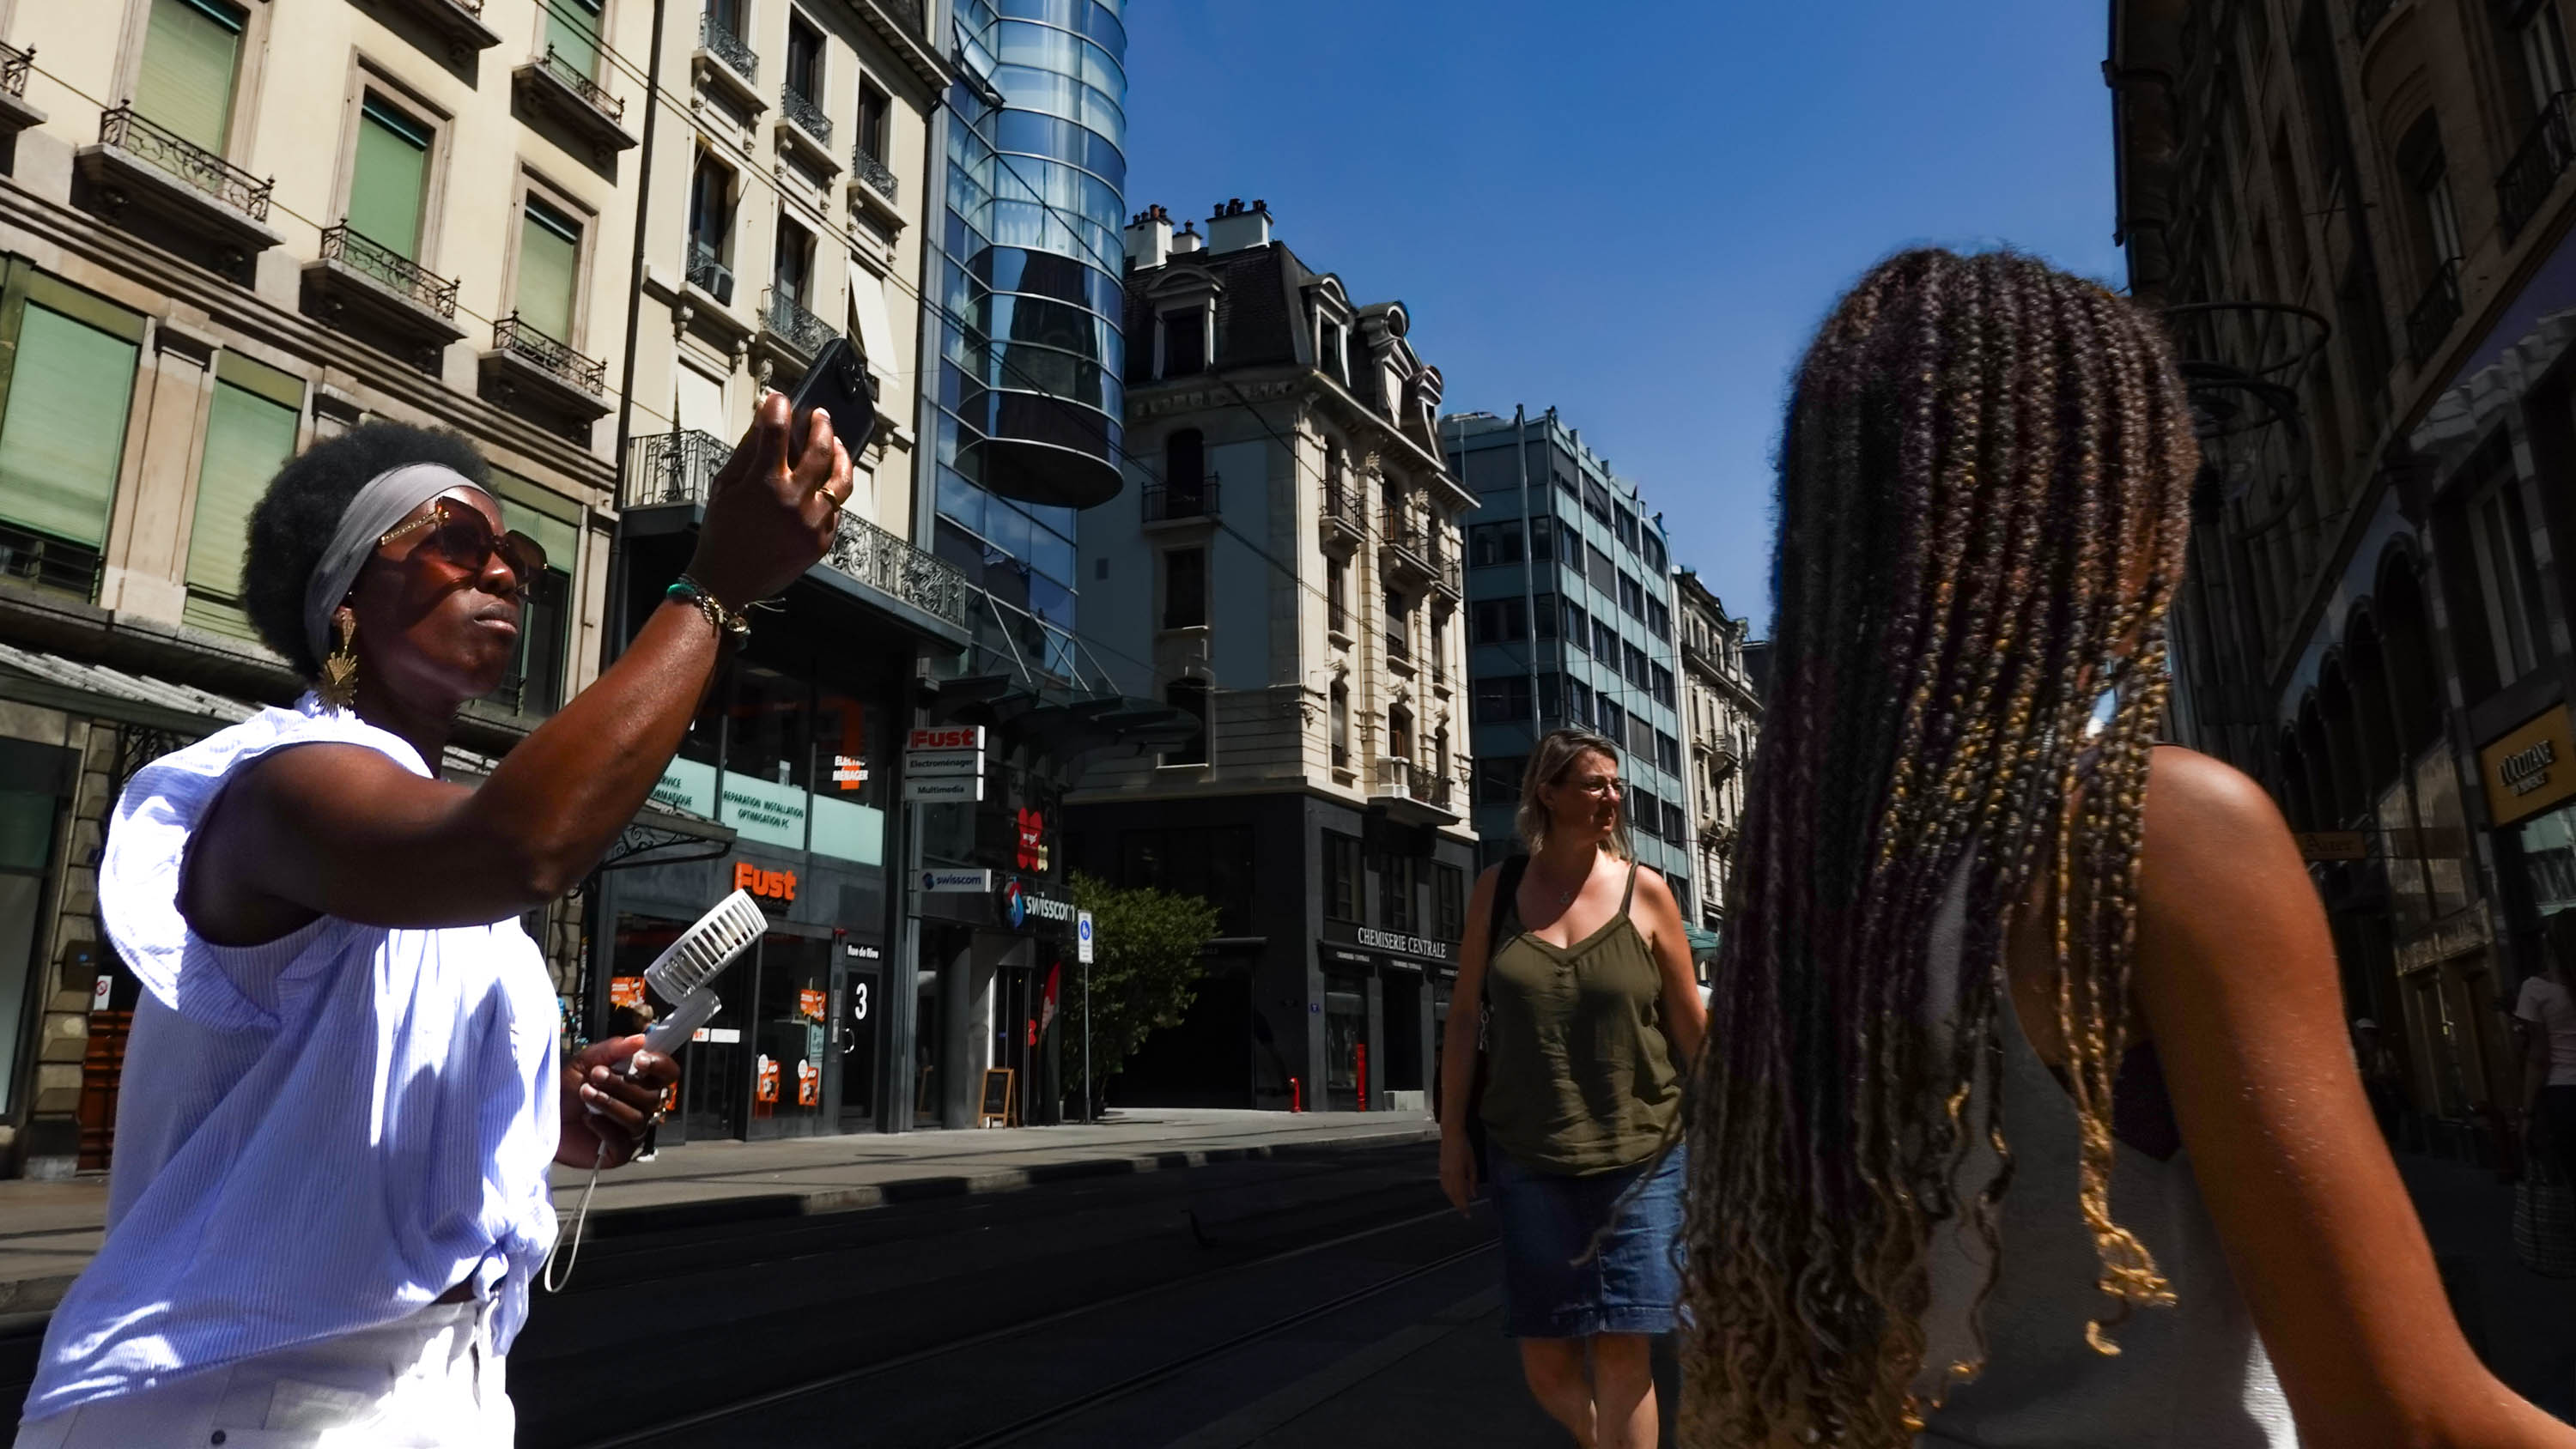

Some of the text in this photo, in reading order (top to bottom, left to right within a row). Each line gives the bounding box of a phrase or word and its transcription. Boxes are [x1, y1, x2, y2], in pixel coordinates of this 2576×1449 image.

[910, 729, 975, 749] Fust
[909, 758, 975, 769] Electroménager
[917, 785, 965, 795] Multimedia
[734, 861, 798, 900] Fust
[936, 873, 981, 885] swisscom
[1025, 891, 1075, 923] swisscom
[847, 944, 859, 957] Rue
[859, 945, 866, 958] de
[1358, 926, 1447, 959] CHEMISERIE CENTRALE
[854, 982, 868, 1021] 3
